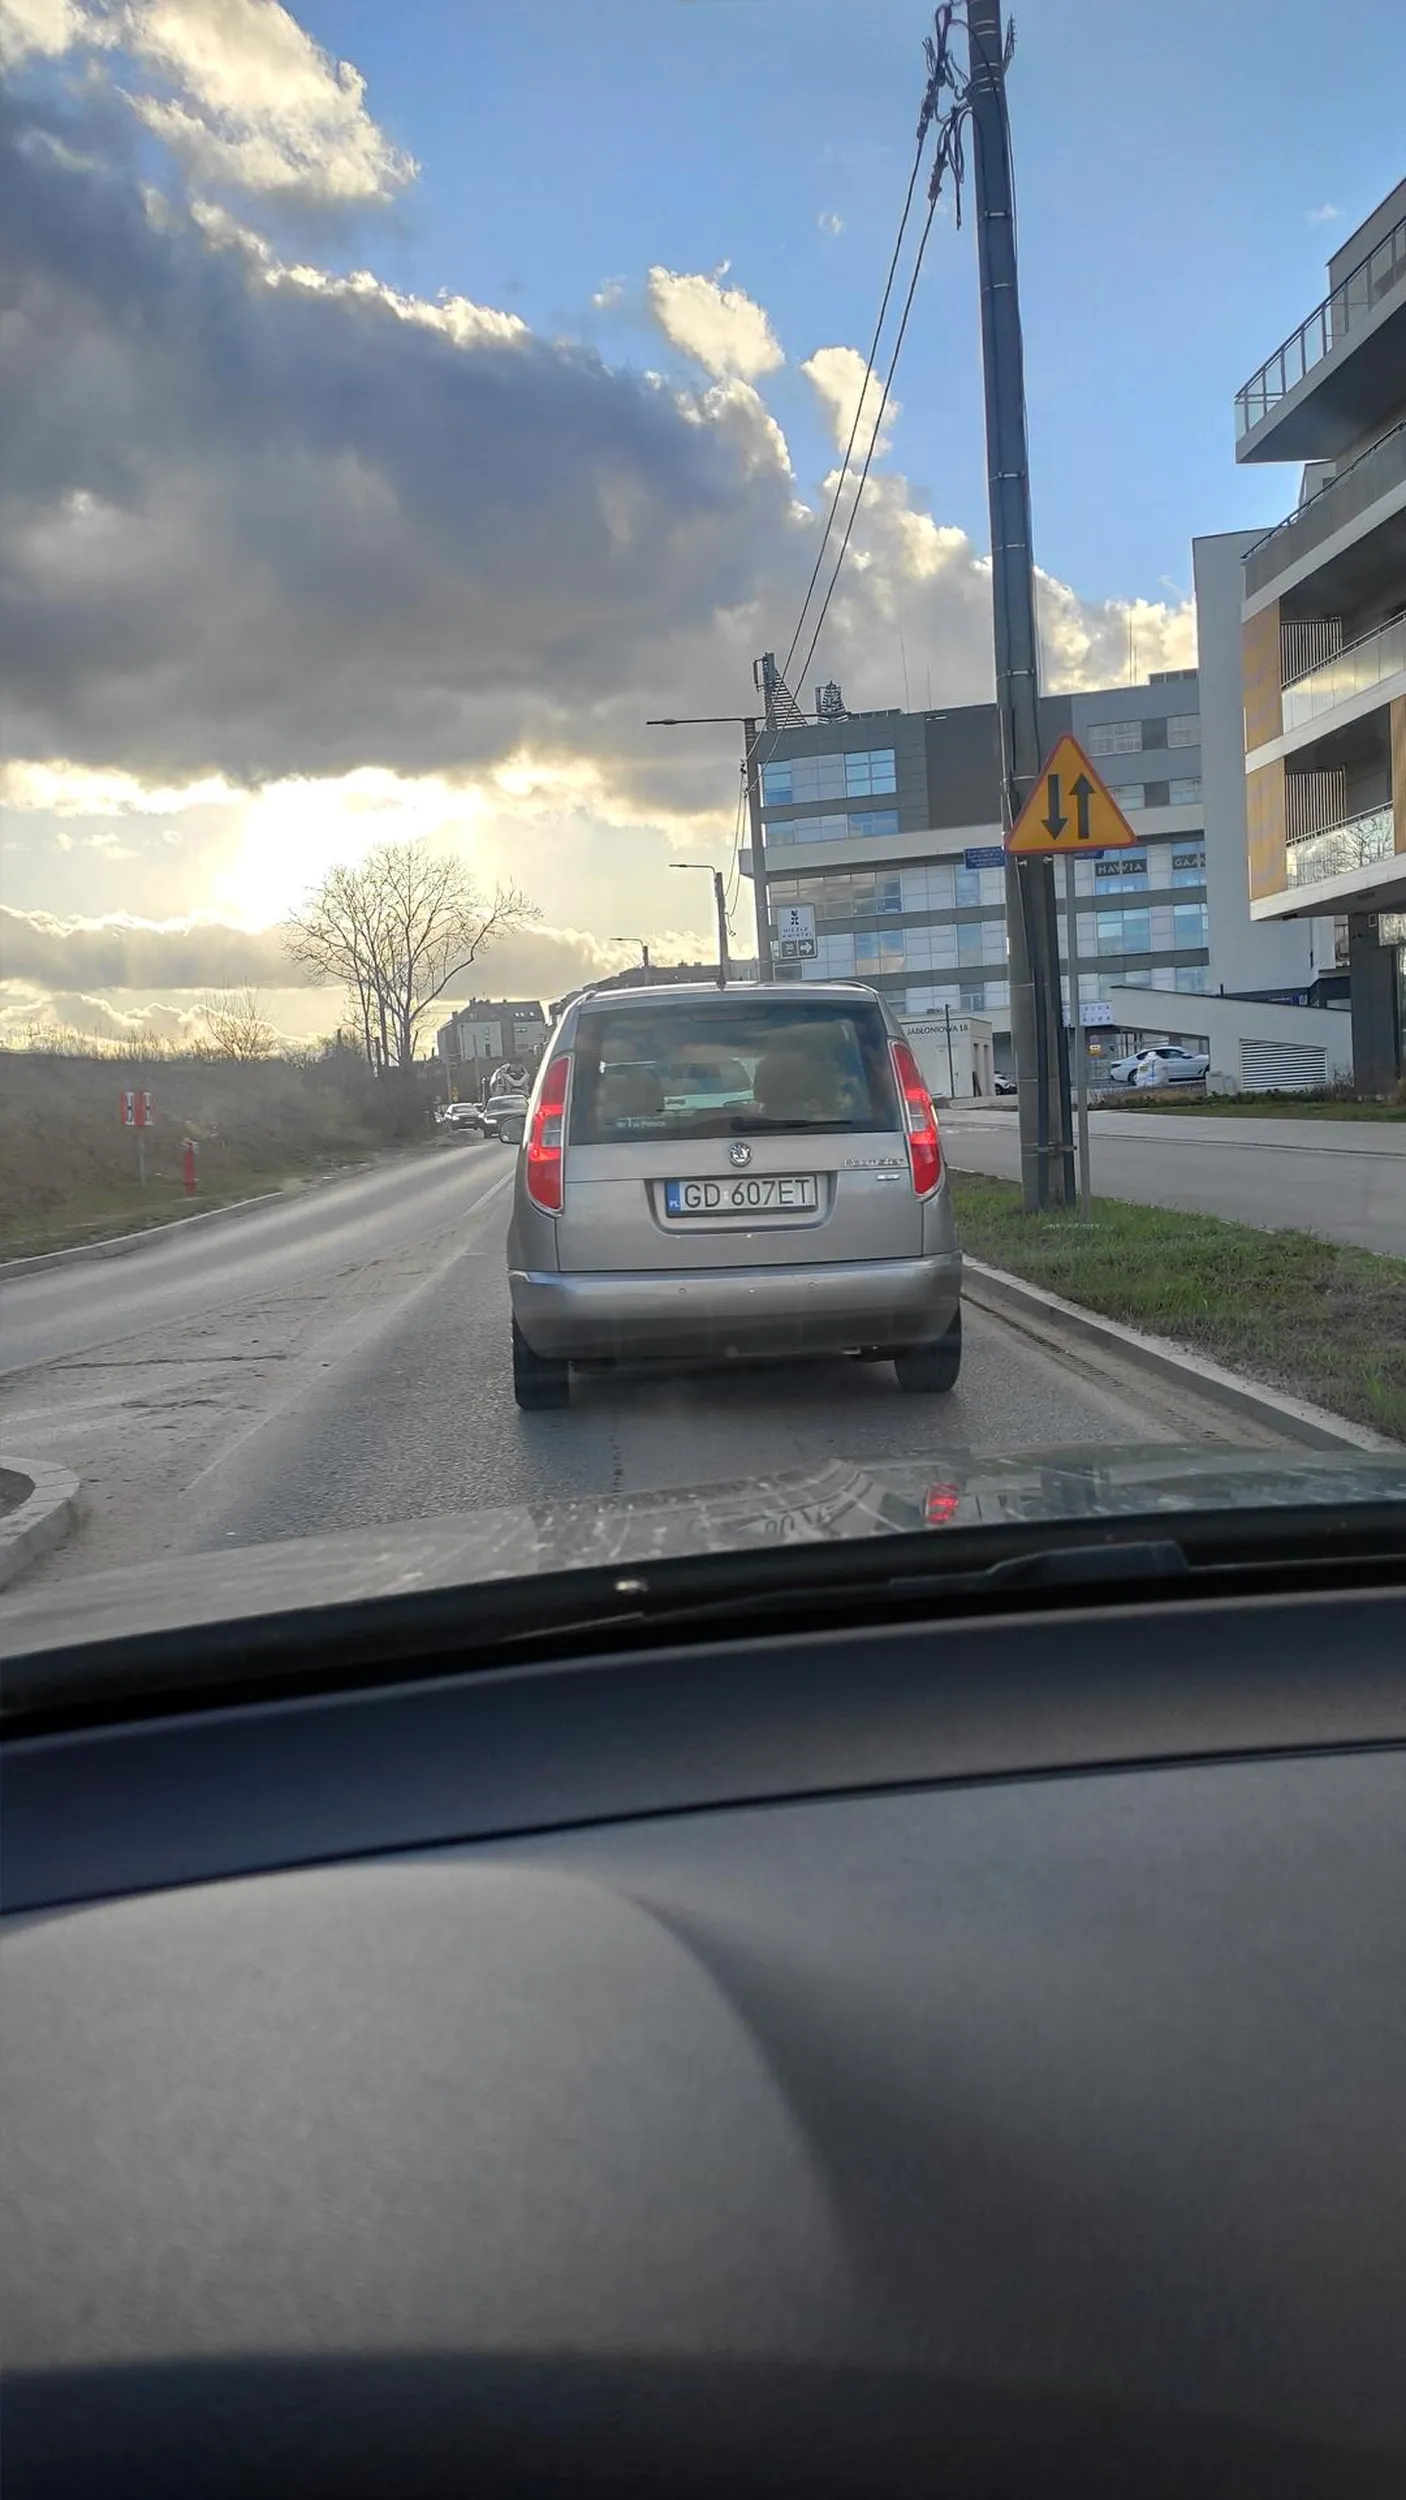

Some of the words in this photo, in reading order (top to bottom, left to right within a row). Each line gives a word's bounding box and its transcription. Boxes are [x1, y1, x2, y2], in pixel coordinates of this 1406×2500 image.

[684, 1181, 721, 1209] GD
[731, 1178, 810, 1207] 607ET
[669, 1200, 680, 1209] PL
